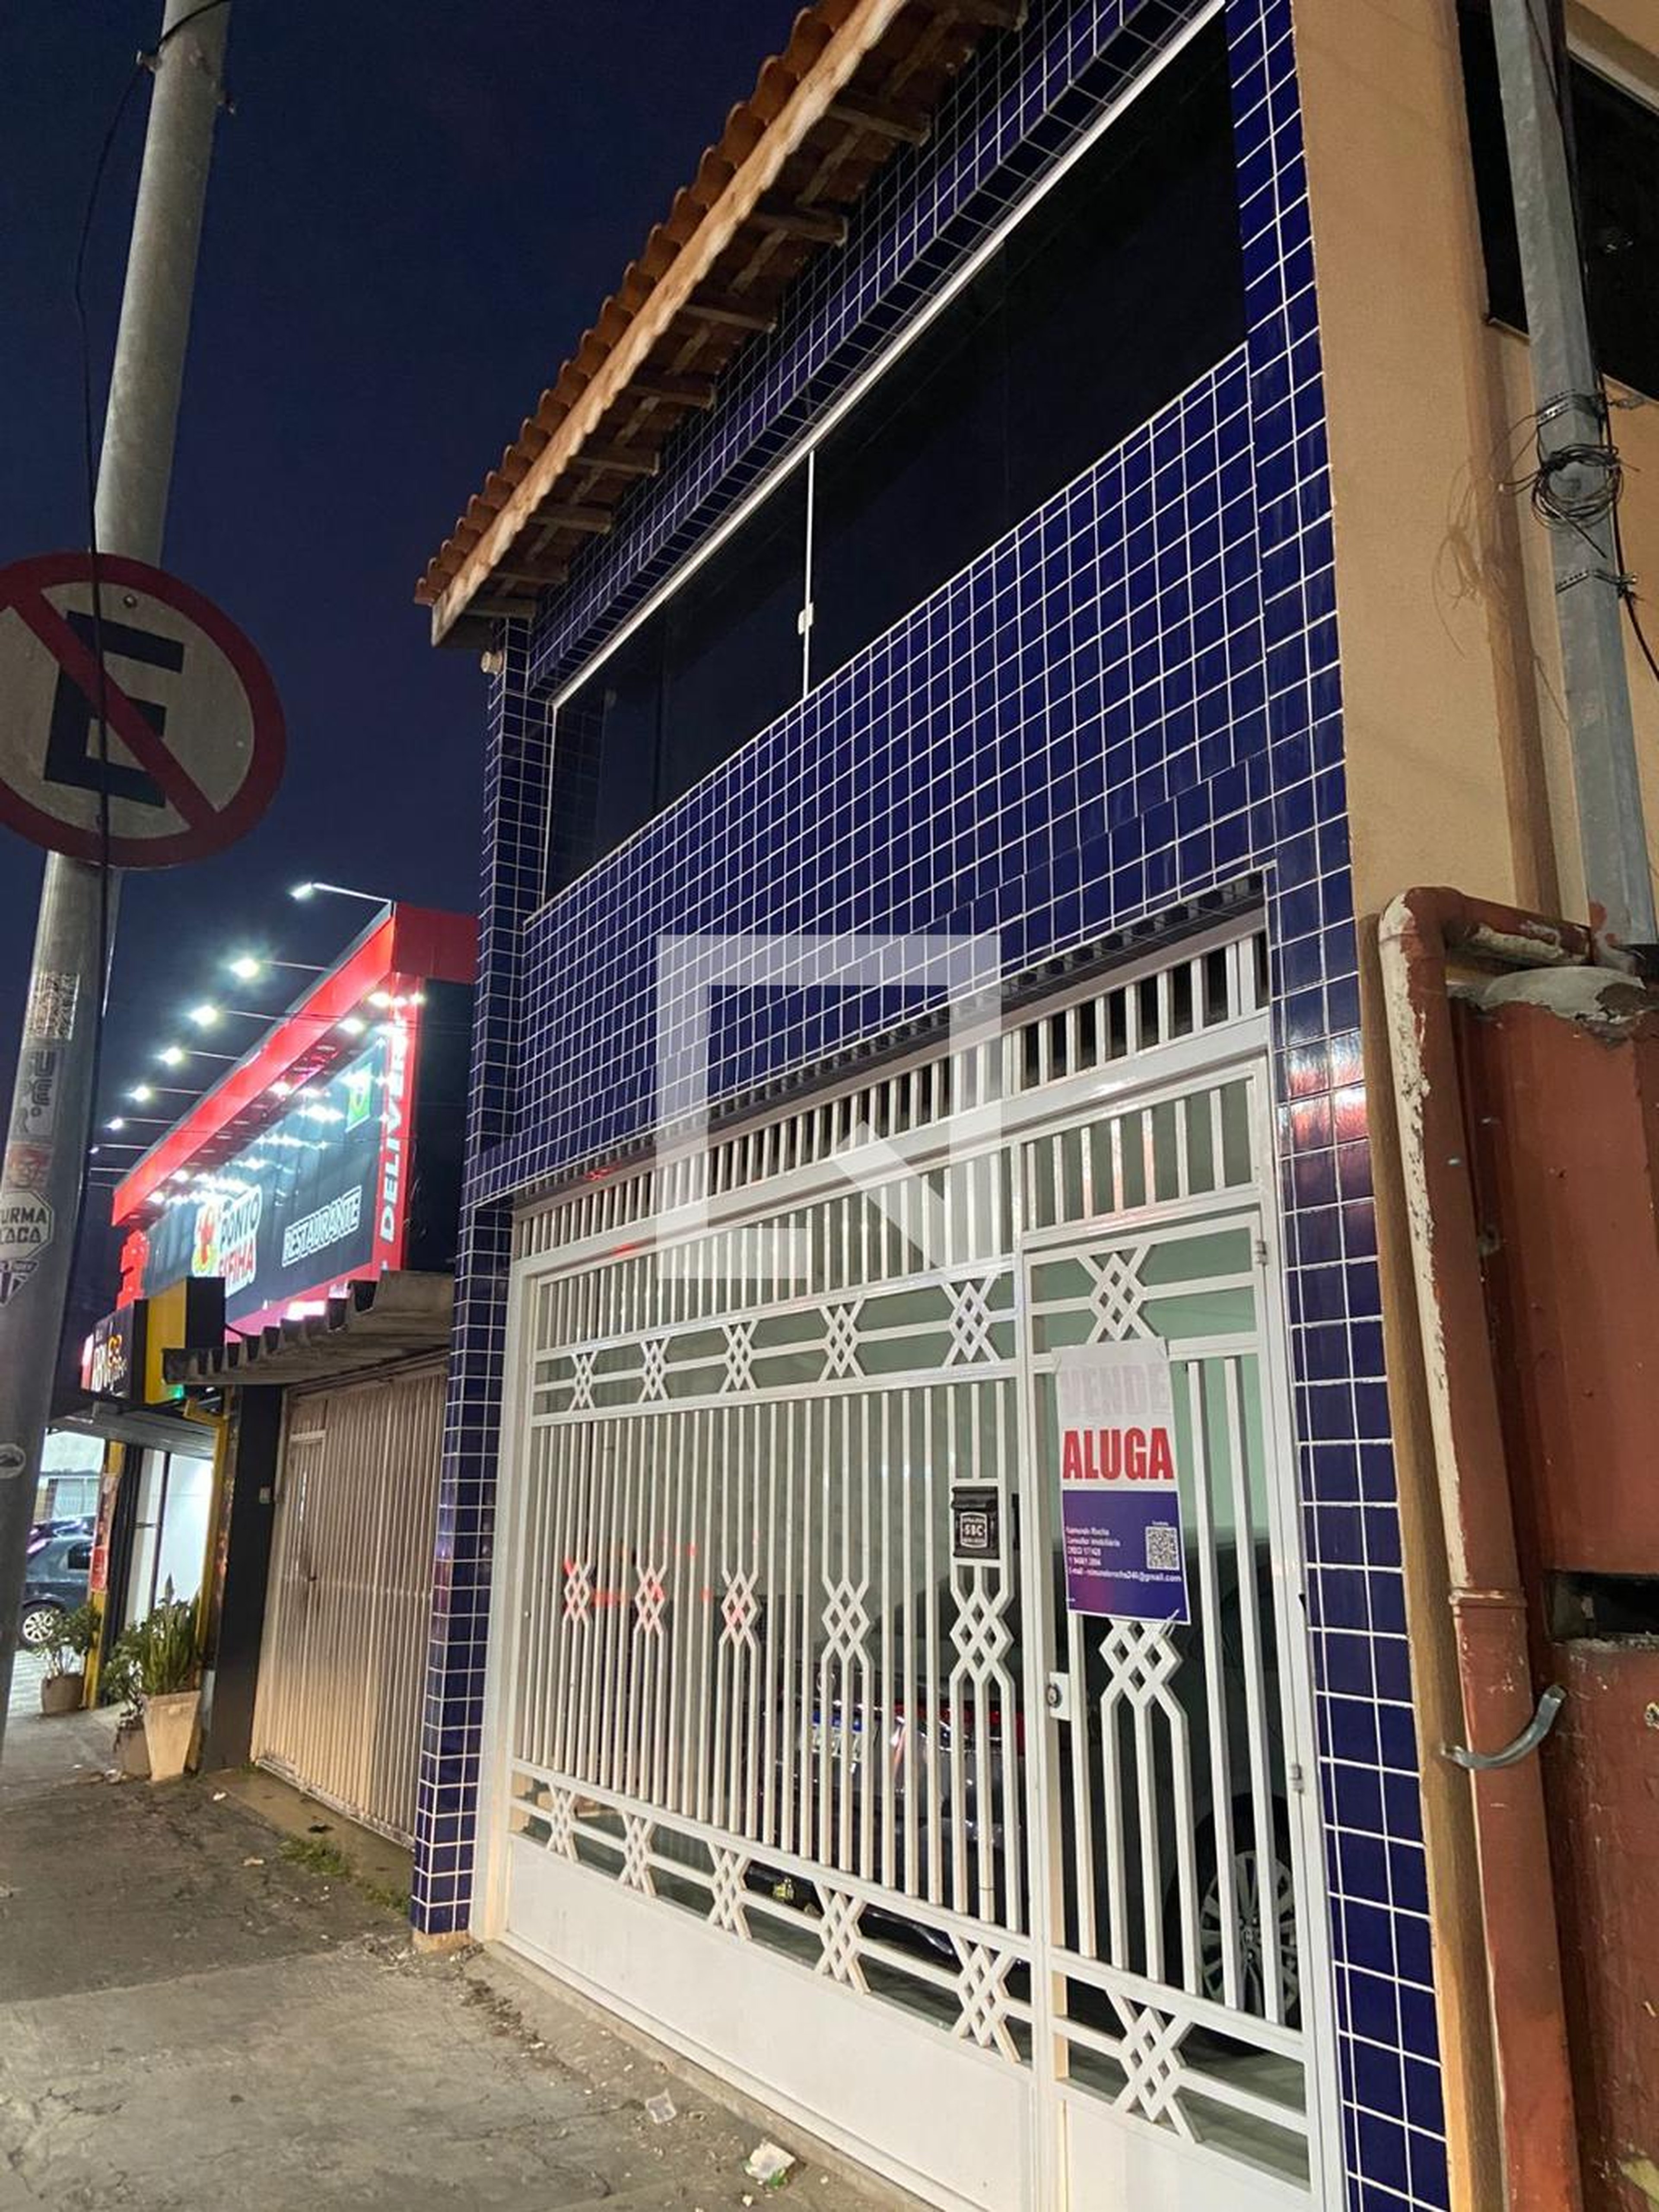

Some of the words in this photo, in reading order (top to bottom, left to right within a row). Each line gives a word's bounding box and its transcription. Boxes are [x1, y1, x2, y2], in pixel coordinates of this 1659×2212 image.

[44, 610, 184, 808] E
[380, 1011, 407, 1243] DELIVER
[283, 1187, 362, 1265] RESTAURANTE
[1063, 1427, 1174, 1480] ALUGA
